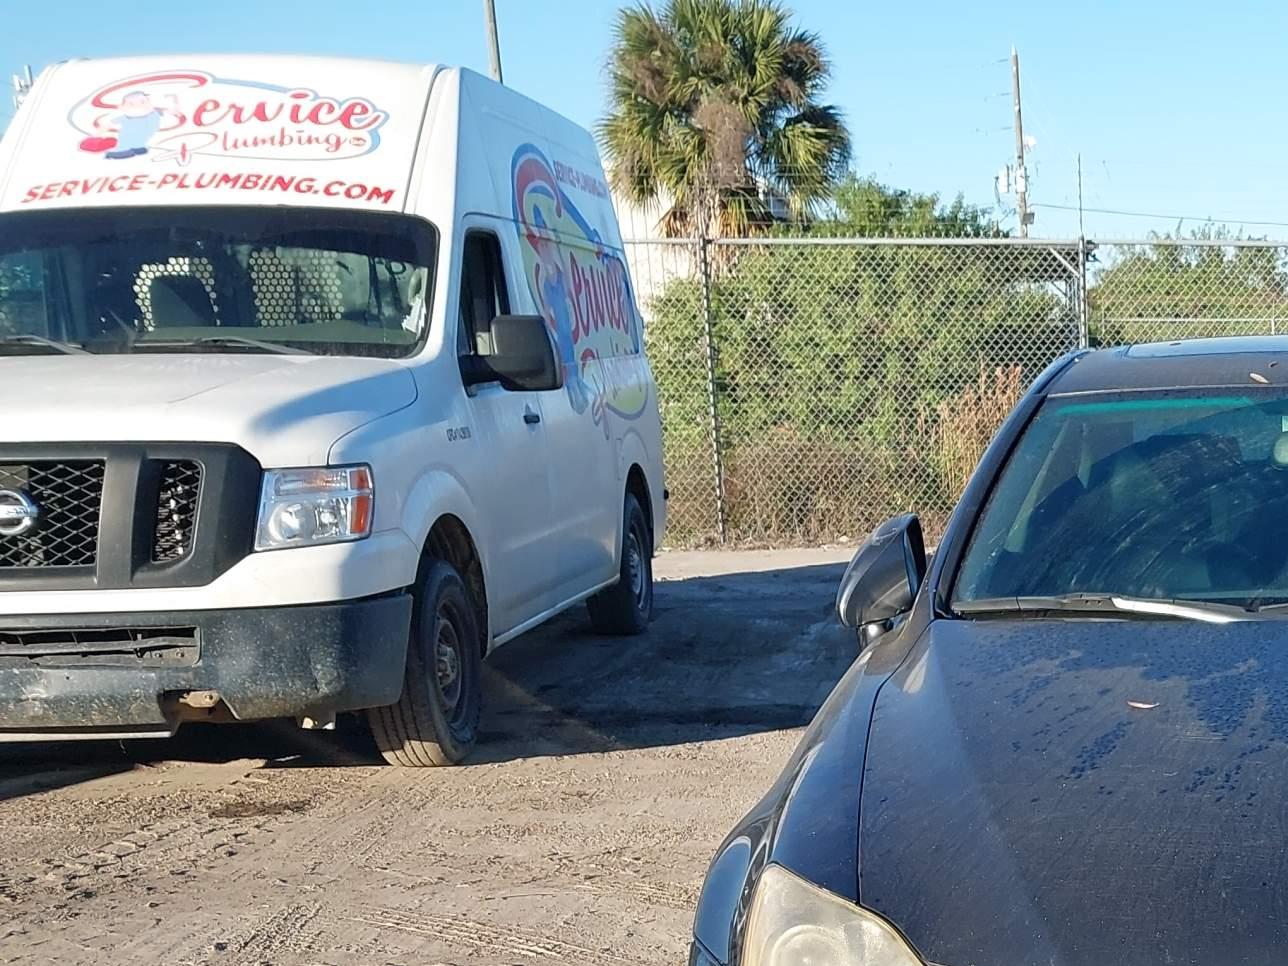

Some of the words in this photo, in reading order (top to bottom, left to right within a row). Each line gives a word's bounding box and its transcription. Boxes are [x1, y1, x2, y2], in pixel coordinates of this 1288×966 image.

[91, 72, 381, 132] Service
[150, 127, 346, 163] Plumbing
[21, 172, 396, 204] SERVICE-PLUMBING.COM
